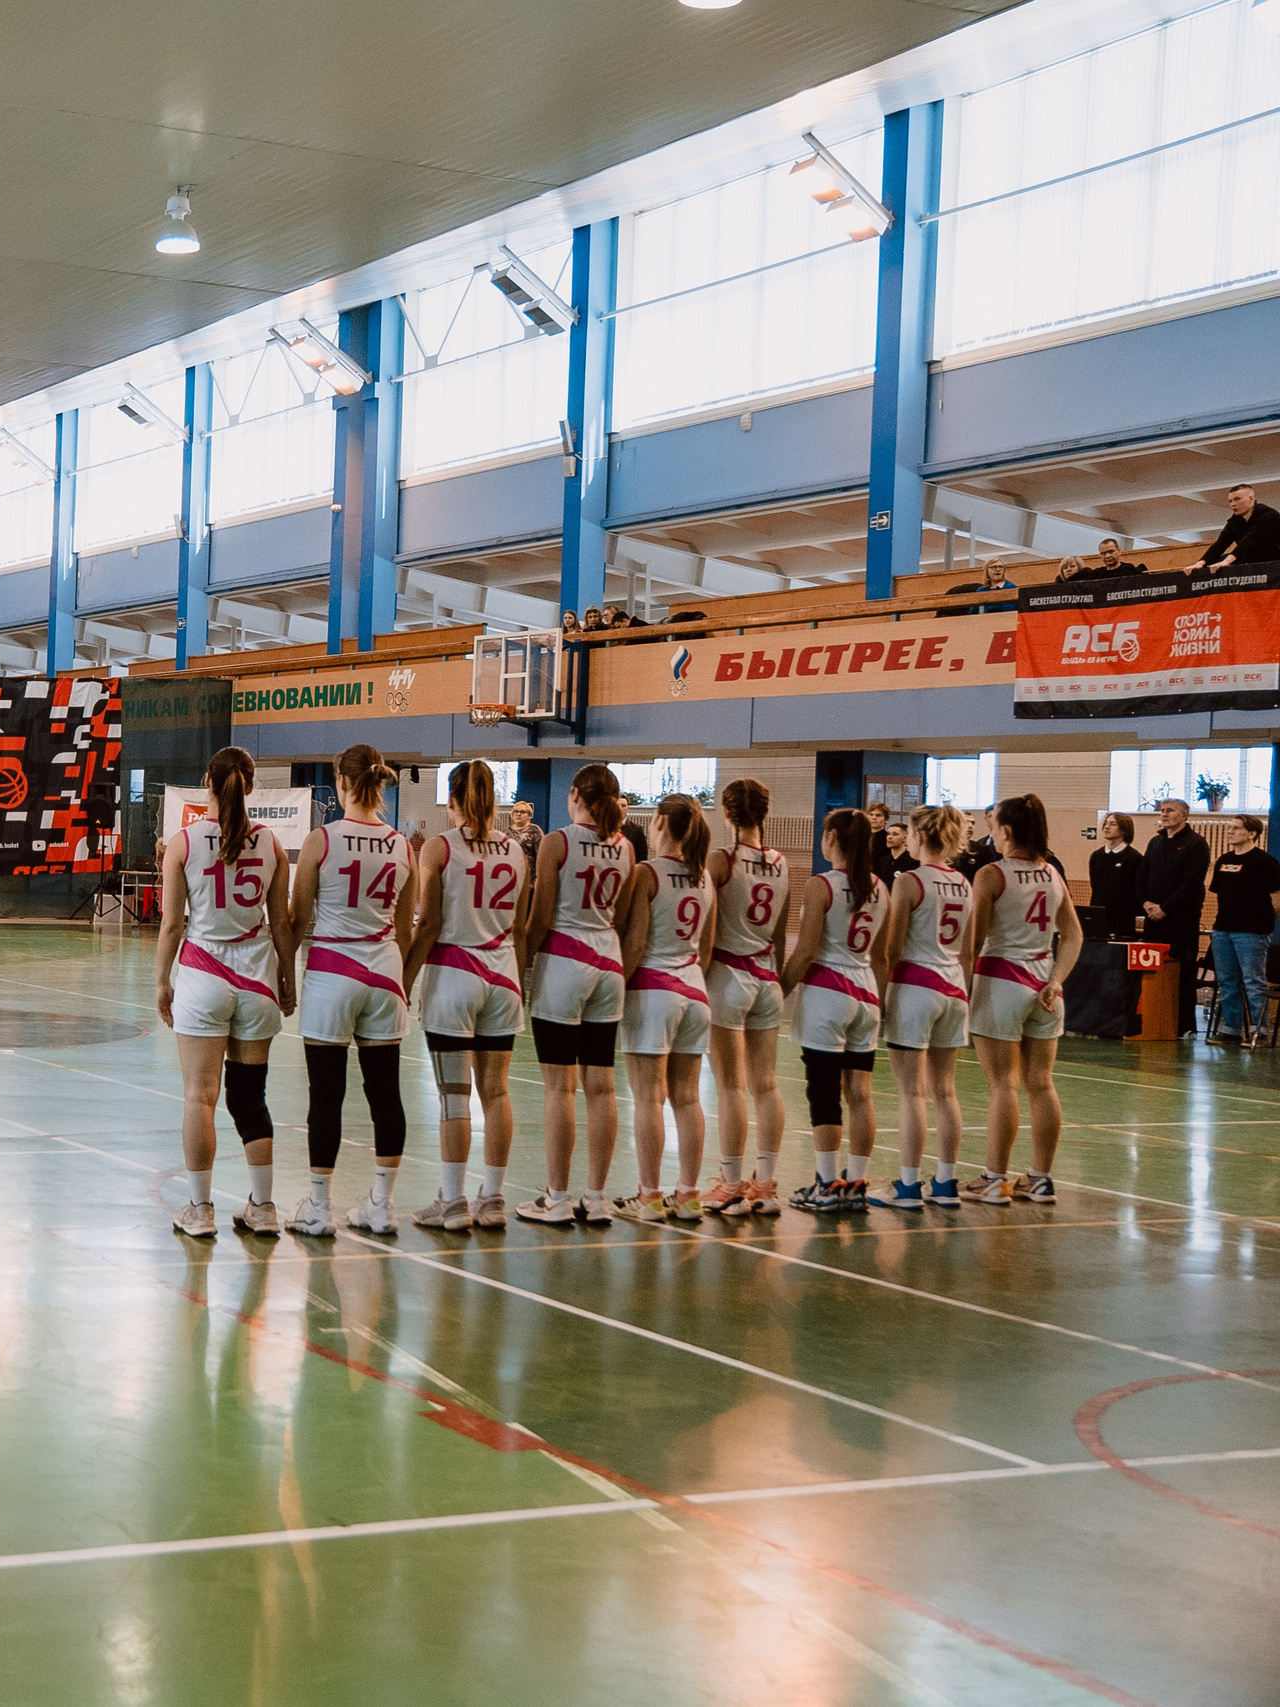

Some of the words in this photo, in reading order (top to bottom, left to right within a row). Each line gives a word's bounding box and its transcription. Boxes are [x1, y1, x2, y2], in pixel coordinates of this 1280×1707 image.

[1173, 626, 1220, 643] НОРМА
[1174, 611, 1211, 629] СПОРТ
[1170, 640, 1220, 658] ЖИЗНИ
[248, 806, 298, 819] СИБУР
[343, 835, 396, 855] ТГПУ
[578, 840, 623, 860] ТГПУ
[203, 858, 263, 909] 15
[339, 859, 396, 909] 14
[465, 861, 517, 910] 12
[575, 865, 621, 910] 10
[932, 880, 969, 898] ТГПУ
[1014, 868, 1052, 884] ТГПУ
[675, 896, 701, 941] 9
[747, 883, 774, 926] 8
[1025, 890, 1051, 932] 4
[847, 911, 874, 954] 6
[938, 903, 963, 945] 5
[1139, 948, 1160, 967] 5
